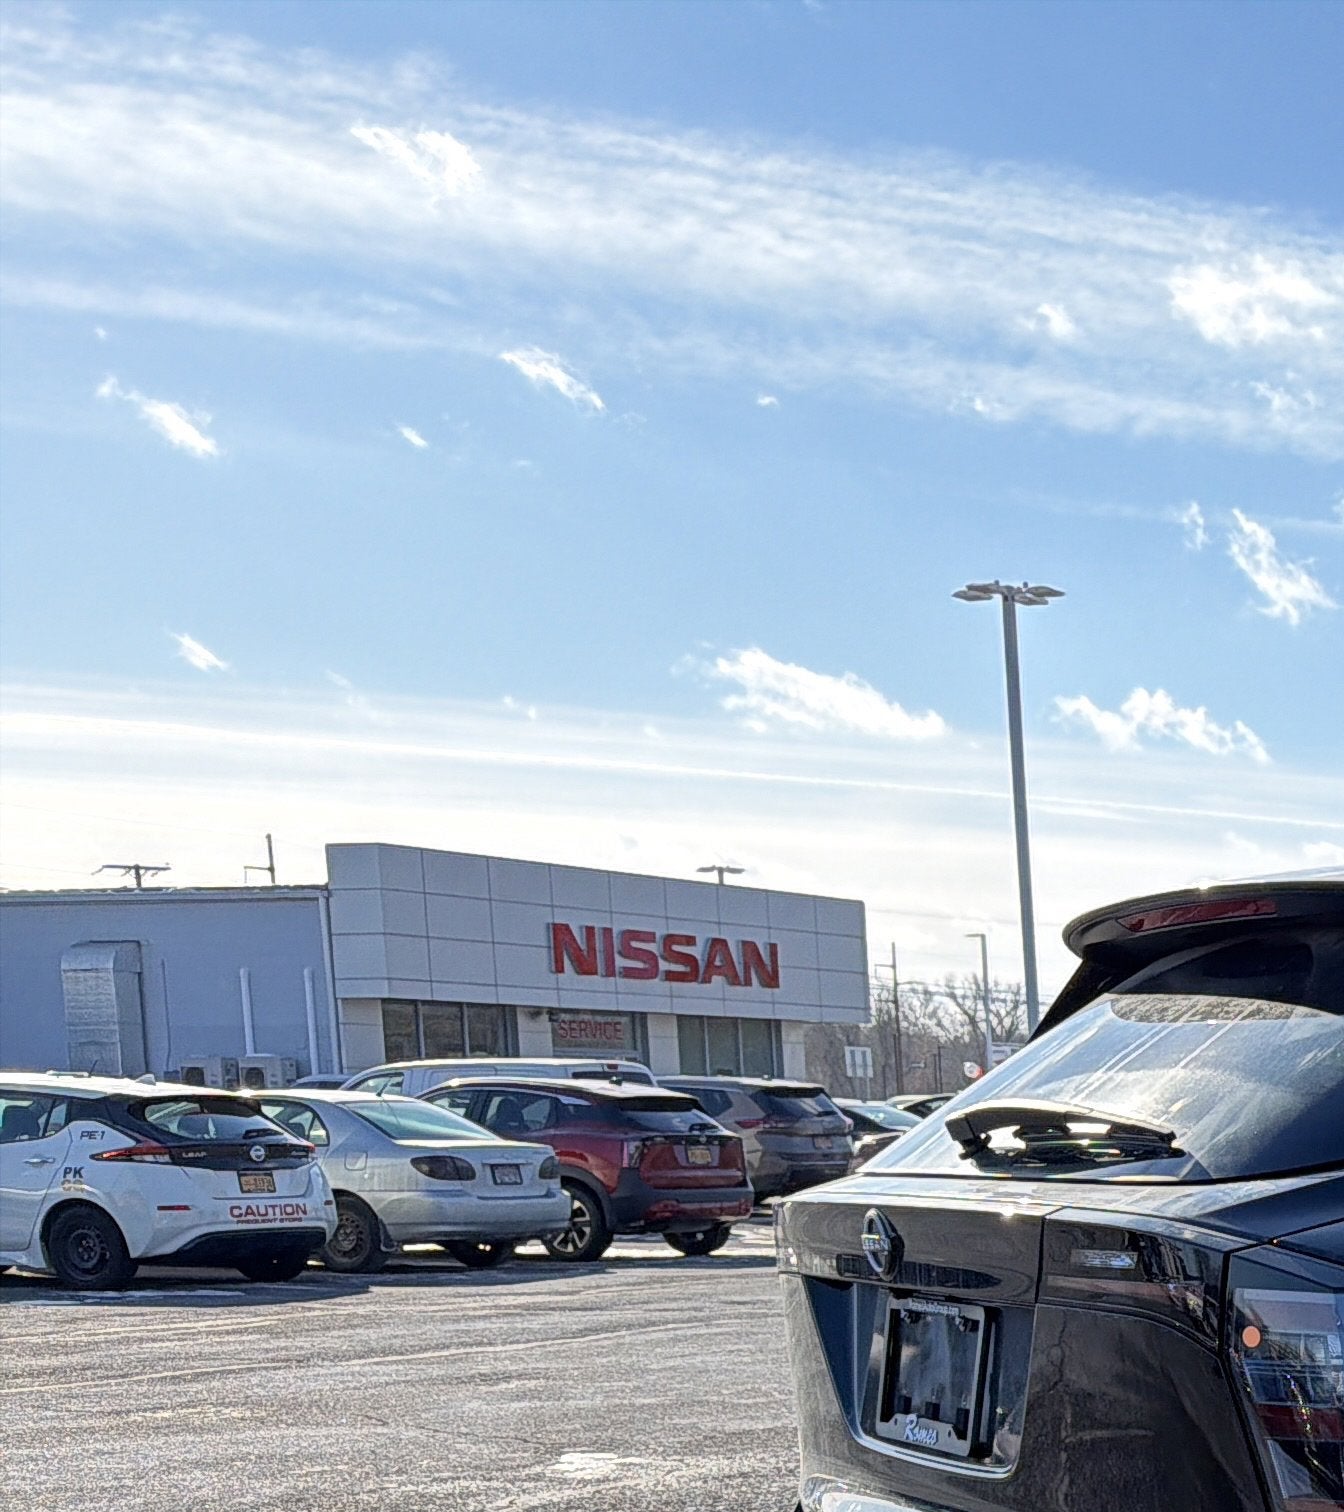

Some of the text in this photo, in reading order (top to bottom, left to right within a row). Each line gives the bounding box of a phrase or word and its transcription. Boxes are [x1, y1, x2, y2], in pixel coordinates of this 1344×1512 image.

[549, 922, 780, 989] NISSAN
[559, 1020, 624, 1040] SERVICE
[63, 1166, 85, 1178] PK
[229, 1203, 308, 1218] CAUTION
